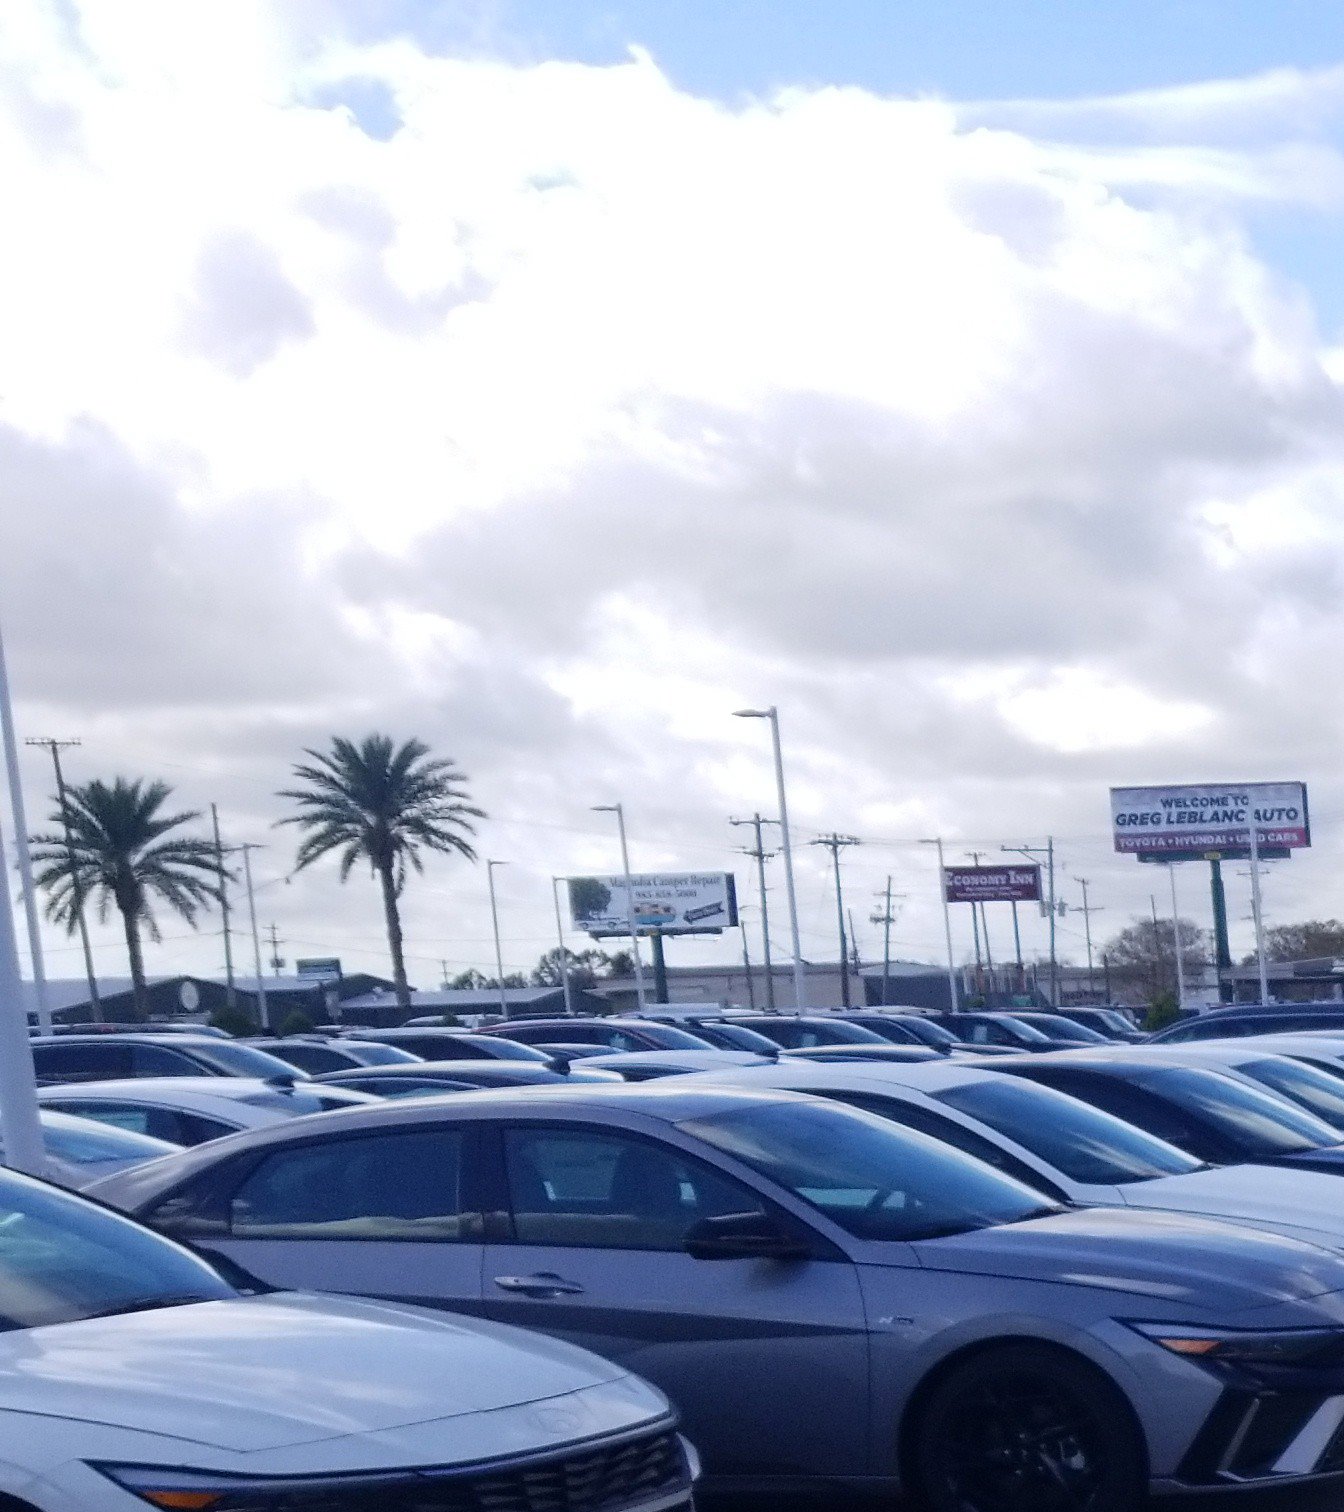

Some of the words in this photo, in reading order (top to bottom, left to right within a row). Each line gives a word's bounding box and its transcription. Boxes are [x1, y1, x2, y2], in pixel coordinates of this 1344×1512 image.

[1160, 796, 1228, 809] WELCOME
[1233, 795, 1250, 806] TO
[1116, 811, 1163, 826] GREG
[1165, 809, 1246, 825] LEBLANC
[1254, 807, 1299, 822] AUTO
[1119, 837, 1165, 848] TOYOTA
[1175, 835, 1227, 846] HYUNDAI
[1236, 833, 1266, 844] USD
[1268, 832, 1298, 843] CARS
[654, 875, 688, 889] Camper
[690, 874, 720, 887] Repair
[945, 871, 1007, 886] ECONOMY
[1008, 870, 1035, 884] INN
